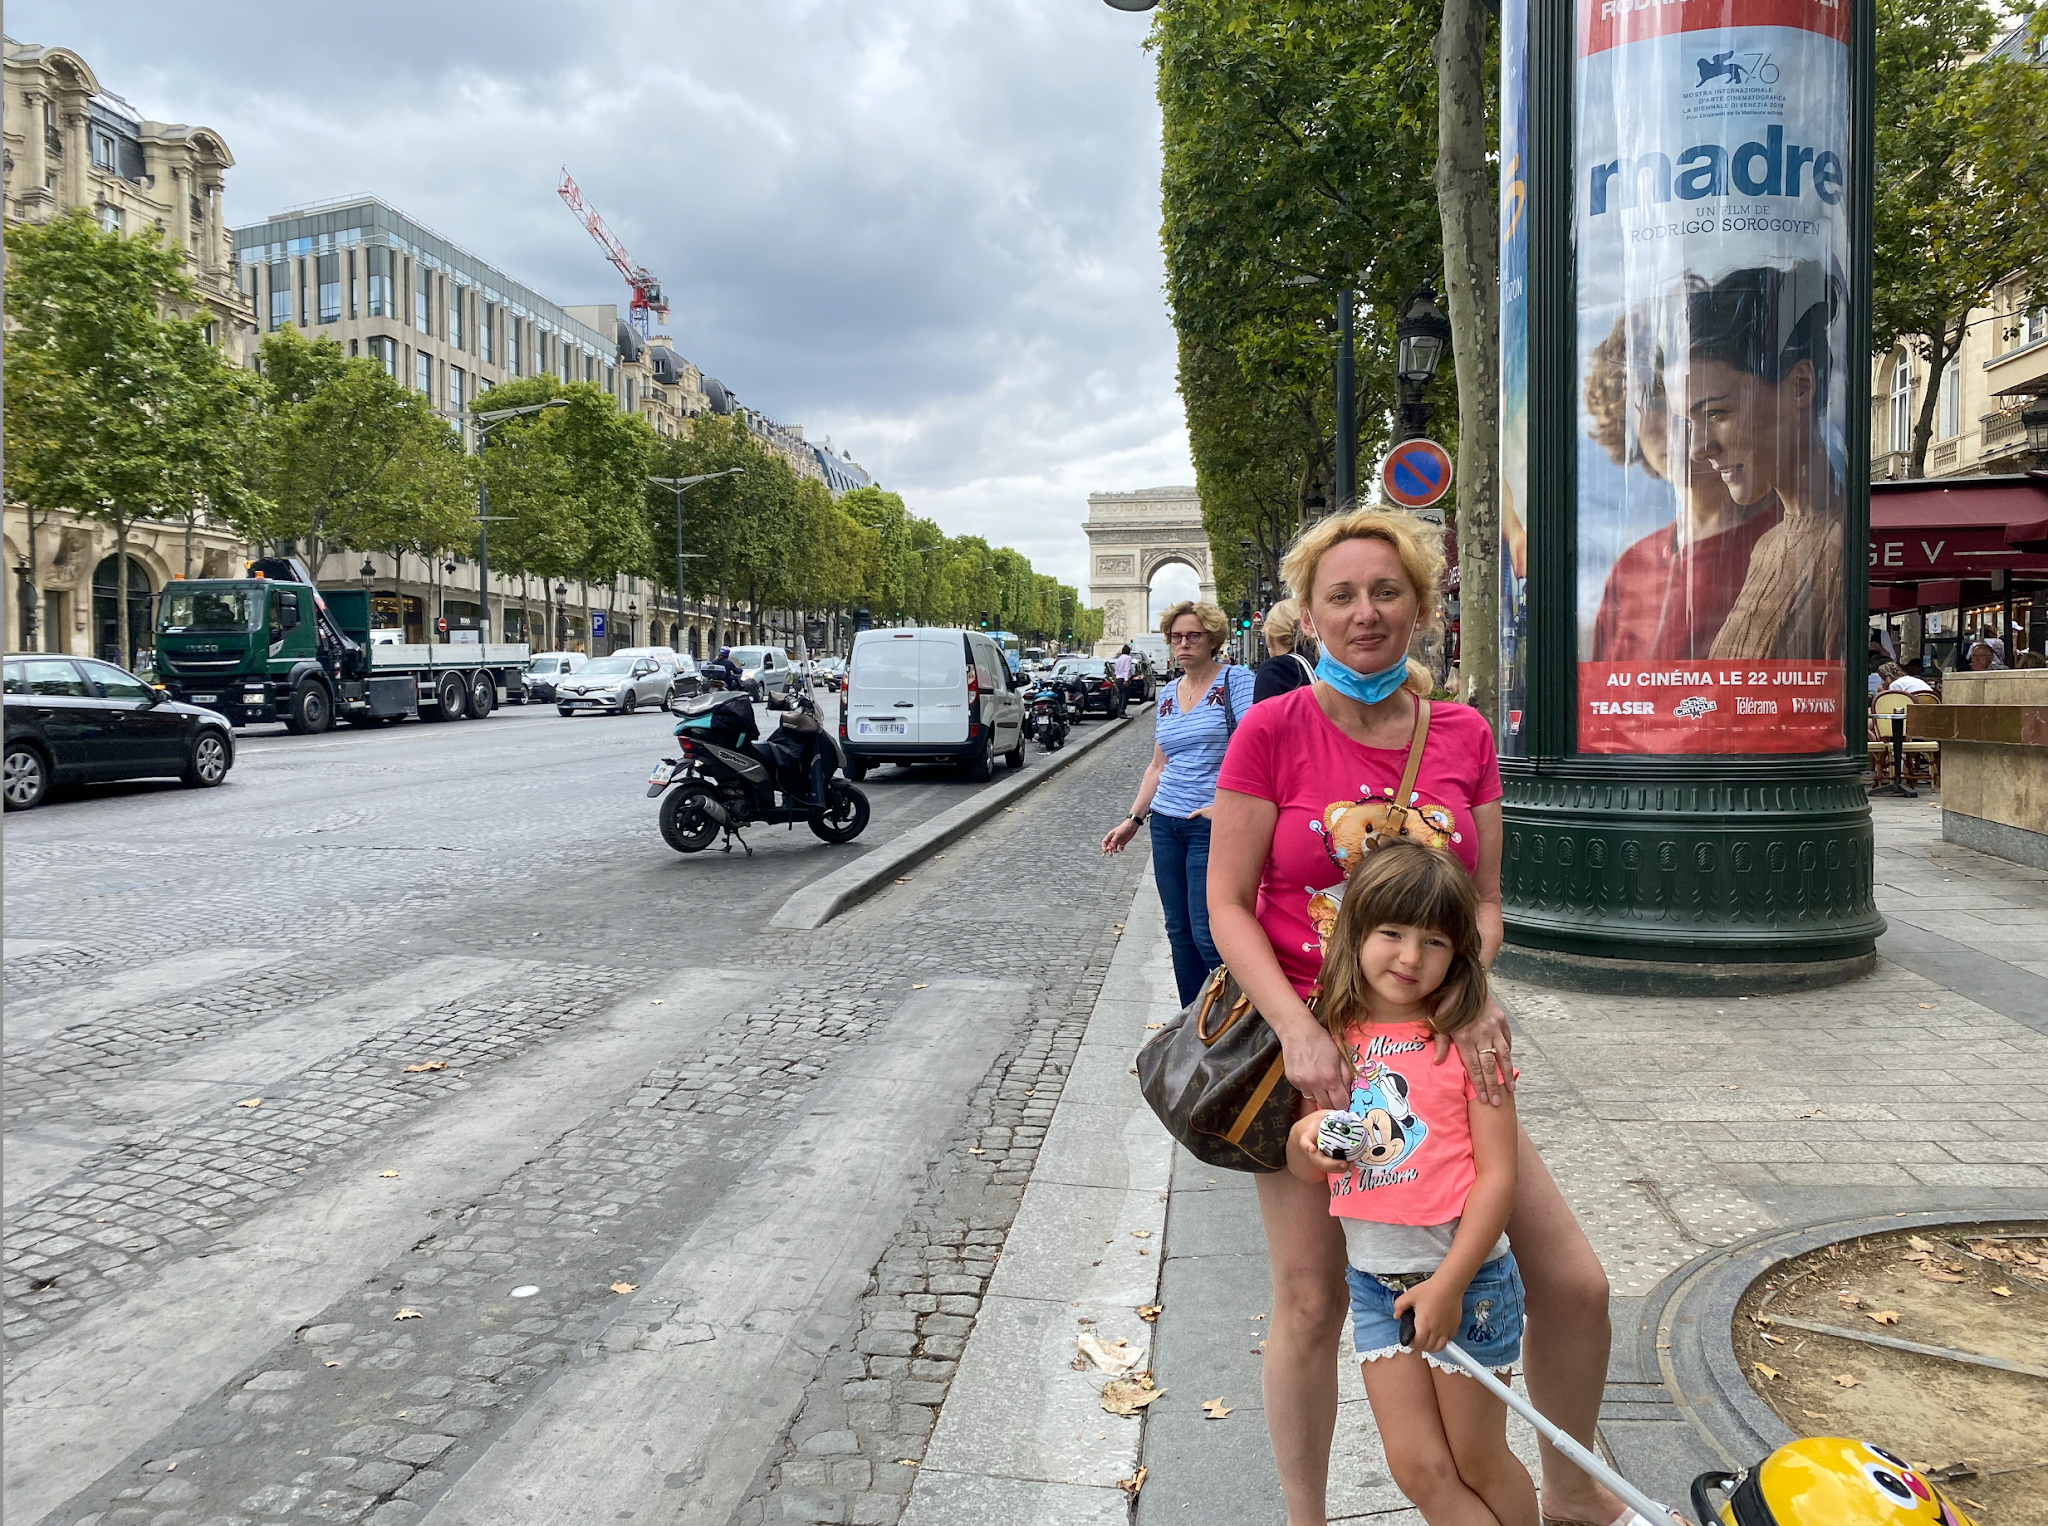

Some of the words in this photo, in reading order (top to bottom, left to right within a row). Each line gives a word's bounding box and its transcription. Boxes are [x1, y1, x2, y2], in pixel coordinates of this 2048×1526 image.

[1743, 53, 1780, 84] 76
[1682, 91, 1712, 99] MOSTRA
[1714, 87, 1772, 95] INTERNAZIONALE
[1698, 96, 1724, 104] D'ARTE
[1693, 102, 1728, 112] BIENNALE
[1590, 124, 1843, 217] madre
[1696, 206, 1716, 217] UN
[1721, 204, 1750, 217] FILM
[1755, 204, 1770, 216] DE
[1630, 218, 1715, 244] RODRIGO
[1722, 217, 1821, 236] SOROGOYEN
[1920, 540, 1946, 565] V
[1606, 673, 1631, 687] AU
[1636, 669, 1714, 687] CINÉMA
[1719, 671, 1743, 686] LE
[1747, 671, 1768, 686] 22
[1772, 671, 1828, 686] JUILLET
[1590, 701, 1655, 715] TEASER
[1674, 701, 1716, 716] CRITIQUE
[1681, 697, 1706, 708] SENS
[1735, 697, 1778, 715] Télérama
[1365, 1034, 1426, 1061] Minnie
[1357, 1167, 1419, 1193] Unicorn
